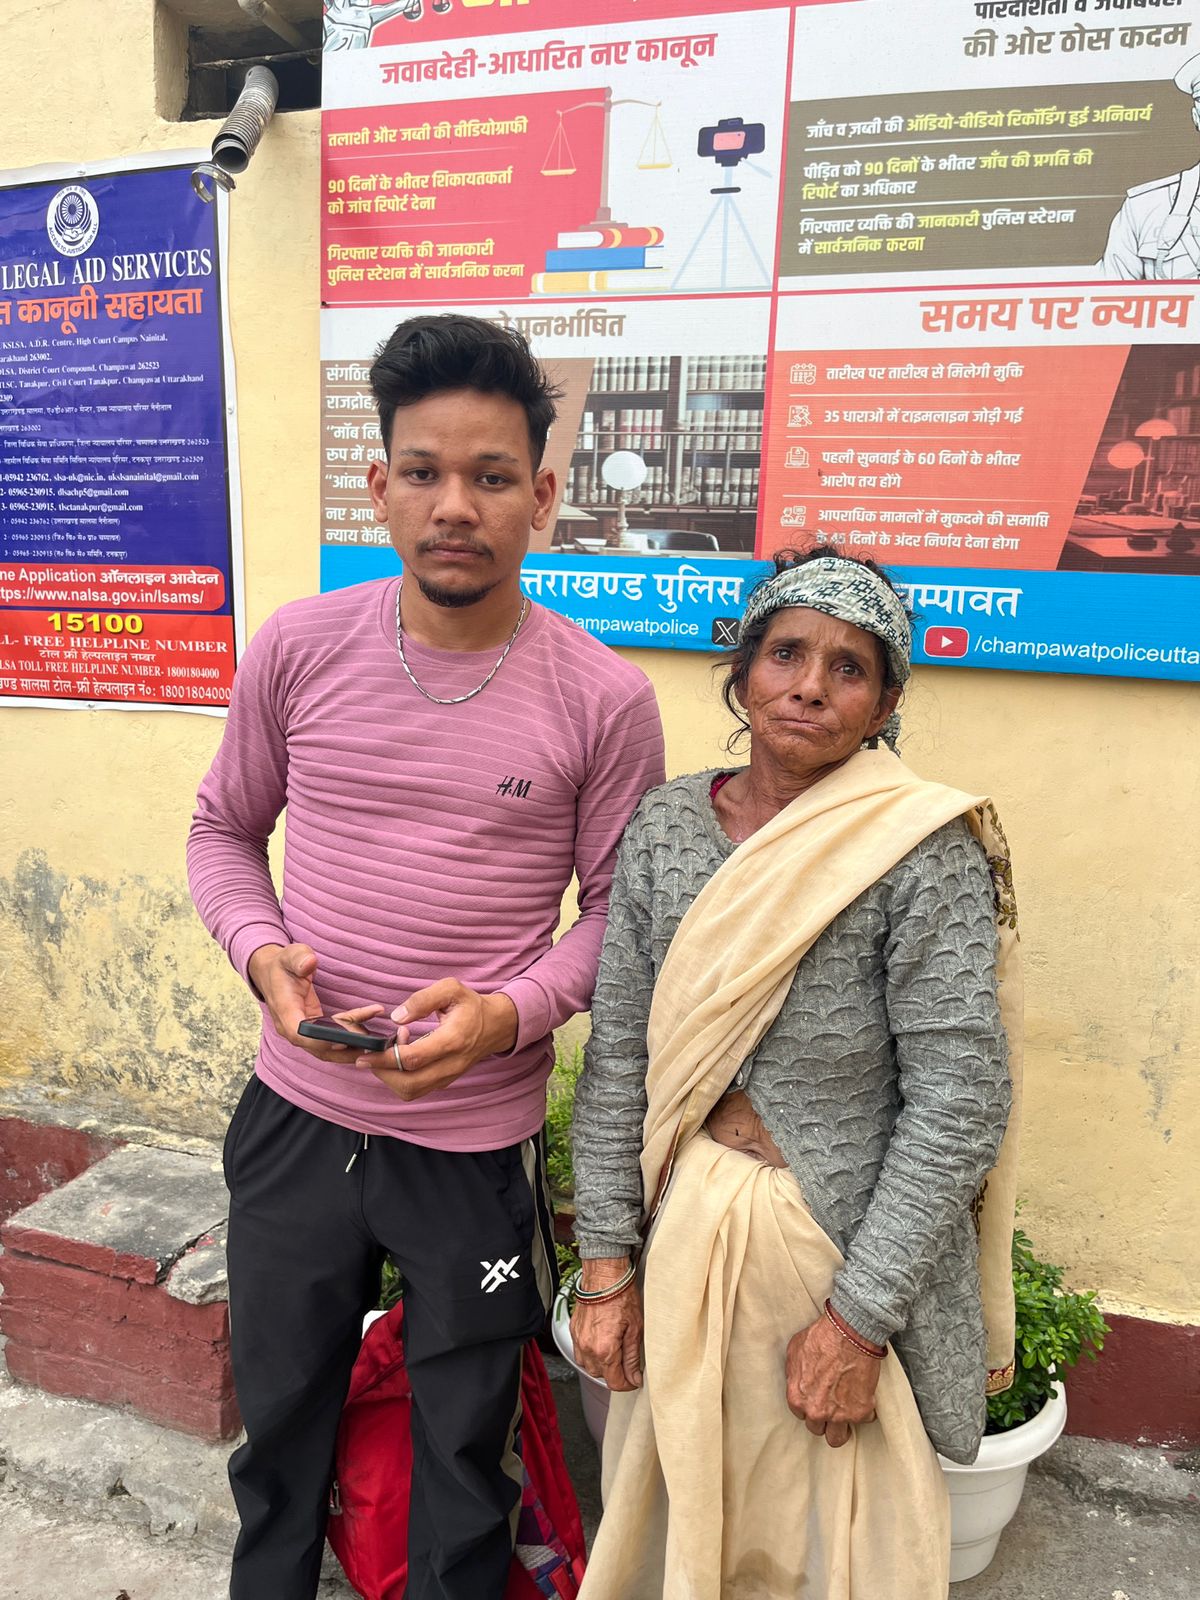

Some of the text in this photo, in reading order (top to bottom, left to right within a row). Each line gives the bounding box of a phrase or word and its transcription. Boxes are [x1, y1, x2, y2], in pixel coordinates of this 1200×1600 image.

[962, 22, 1192, 58] की ओर ठोस कदम
[380, 32, 719, 84] जवाबदेही-आधारित नए कानून
[328, 115, 528, 147] तलाशी और जब्ती की वीडियोग्राफी
[806, 118, 835, 138] जाँच
[836, 123, 848, 136] व
[884, 116, 904, 133] की
[906, 110, 1006, 132] ऑडियो-वीडियो
[1007, 106, 1066, 127] रिकॉर्डिंग
[1068, 106, 1090, 128] हुई
[1092, 103, 1153, 122] अनिवार्य
[803, 148, 1094, 181] पीड़ित को 90 दिनों के भीतर जाँच की प्रगति की
[328, 165, 513, 194] 90 दिनों के भीतर शिकायतकर्ता
[802, 179, 918, 200] रिपोर्ट का अधिकार
[327, 194, 437, 214] को जांच रिपोर्ट देना
[799, 207, 1077, 235] गिरफ्तार व्यक्ति की जानकारी पुलिस स्टेशन
[327, 238, 495, 261] गिरफ्तार व्यक्ति की जानकारी
[798, 236, 926, 255] में सार्वजनिक करना
[2, 248, 213, 290] LEGAL AID SERVICES
[327, 261, 525, 287] पुलिस स्टेशन में सार्वजनिक करना
[17, 284, 98, 335] कानूनी
[104, 288, 203, 320] सहायता
[919, 294, 1195, 334] समय पर न्याय
[826, 362, 1024, 382] तारीख पर तारीख से मिलेगी मुक्ति
[824, 407, 1024, 426] 35 धाराओं में टाइमलाइन जोड़ी गई
[350, 445, 364, 462] में
[822, 448, 1021, 468] पहली सुनवाई के 60 दिनों के भीतर
[820, 472, 902, 489] आरोप तय होंगे
[325, 507, 347, 521] नए
[818, 507, 1049, 528] आपराधिक मामलों में मुकदमे की समाप्ति
[325, 528, 358, 543] न्याय
[849, 530, 878, 545] दिनों
[879, 531, 892, 545] के
[894, 531, 921, 547] अंदर
[924, 531, 962, 548] निर्णय
[965, 533, 990, 549] देना
[992, 535, 1020, 550] होगा
[18, 568, 220, 585] Application ऑनलाइन आवेदन
[520, 563, 744, 613] त्तराखण्ड पुलिस
[47, 612, 144, 634] 15100
[24, 635, 228, 653] FREE HELPLINE NUMBER
[39, 647, 60, 659] टोल
[63, 648, 78, 660] फ्री
[81, 649, 129, 662] हेल्पलाइन
[18, 660, 220, 679] TOLL FREE HELPLINE NUMBER- 18001804000
[19, 678, 50, 692] सालसा
[93, 680, 136, 697] हेल्पलाइन
[160, 684, 232, 701] 18001804000
